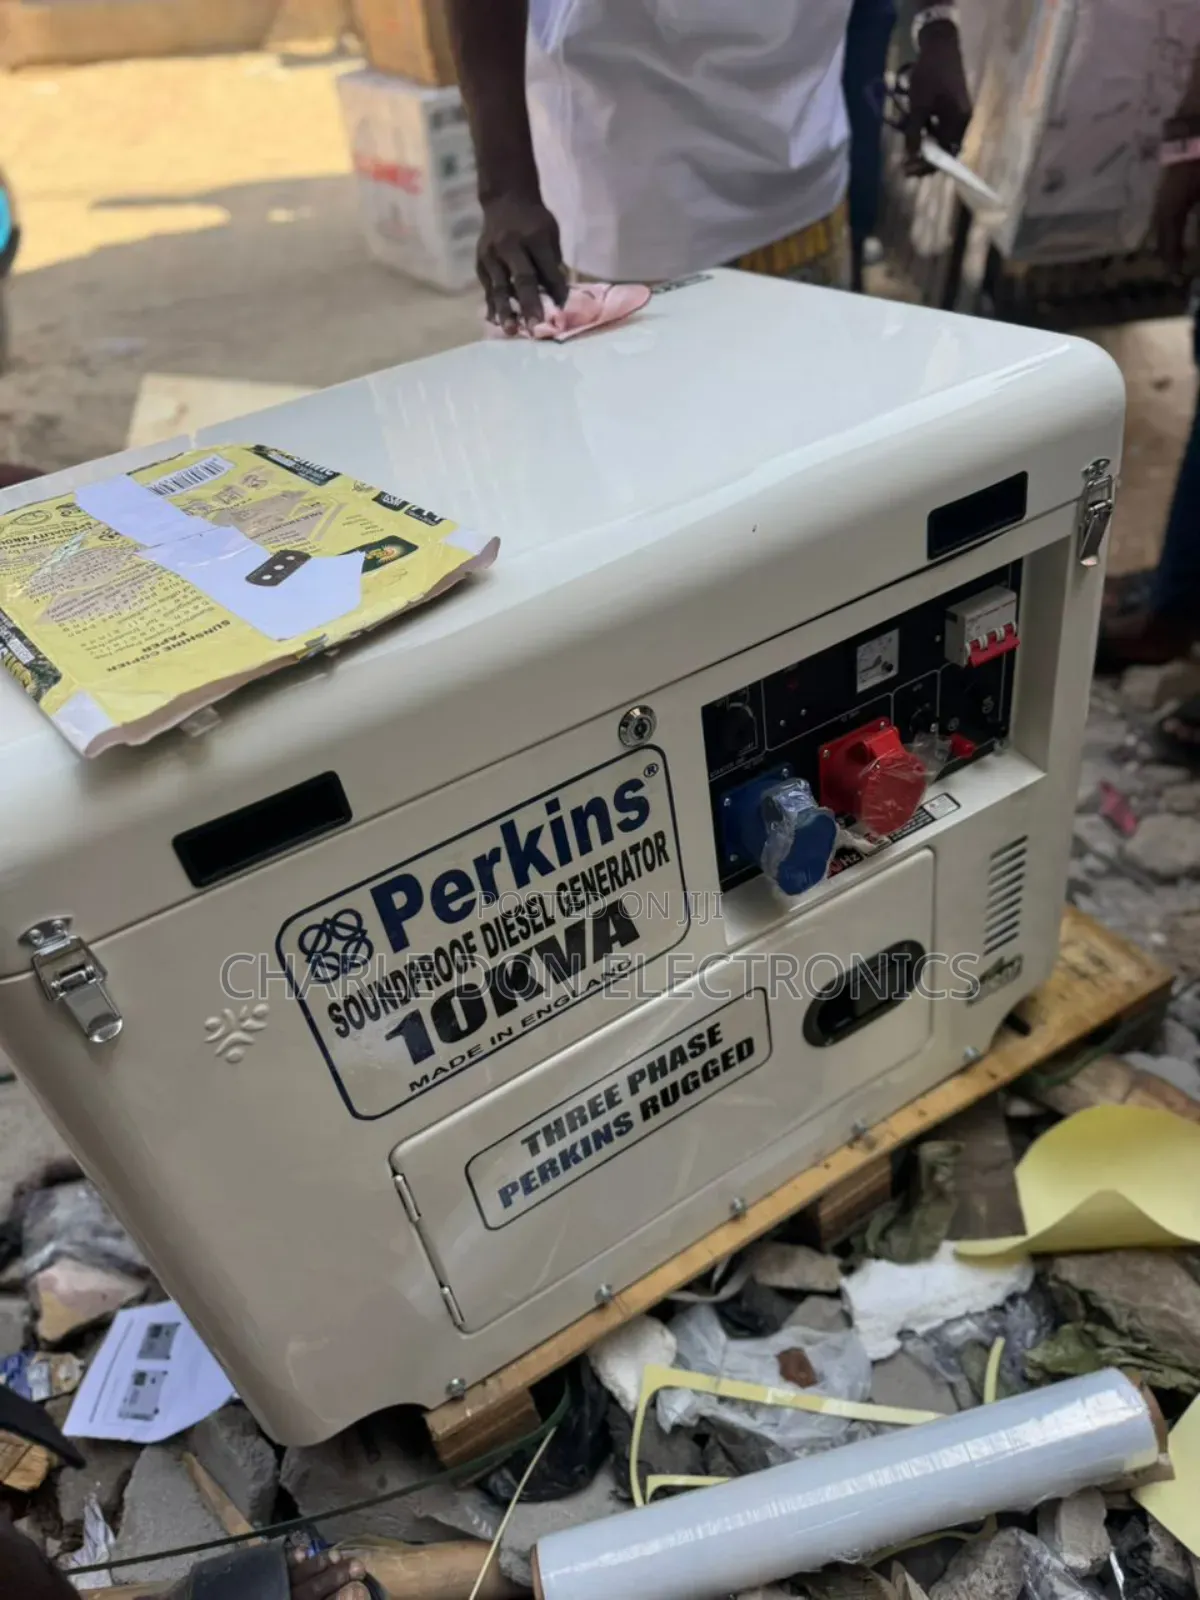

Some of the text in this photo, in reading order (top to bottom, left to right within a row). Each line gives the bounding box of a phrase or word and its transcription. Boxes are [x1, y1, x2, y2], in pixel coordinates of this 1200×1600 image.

[105, 650, 161, 673] COPIER
[141, 630, 188, 653] PAPER
[162, 619, 231, 652] SUNSHINE
[327, 829, 671, 1038] SOUNDPROOF DIESEL GENERATOR
[384, 898, 641, 1065] 10KVA
[408, 958, 632, 1092] MADE IN ENGLAND
[520, 1022, 723, 1158] THREE PHASE
[497, 1036, 755, 1210] PERKINS RUGGED
